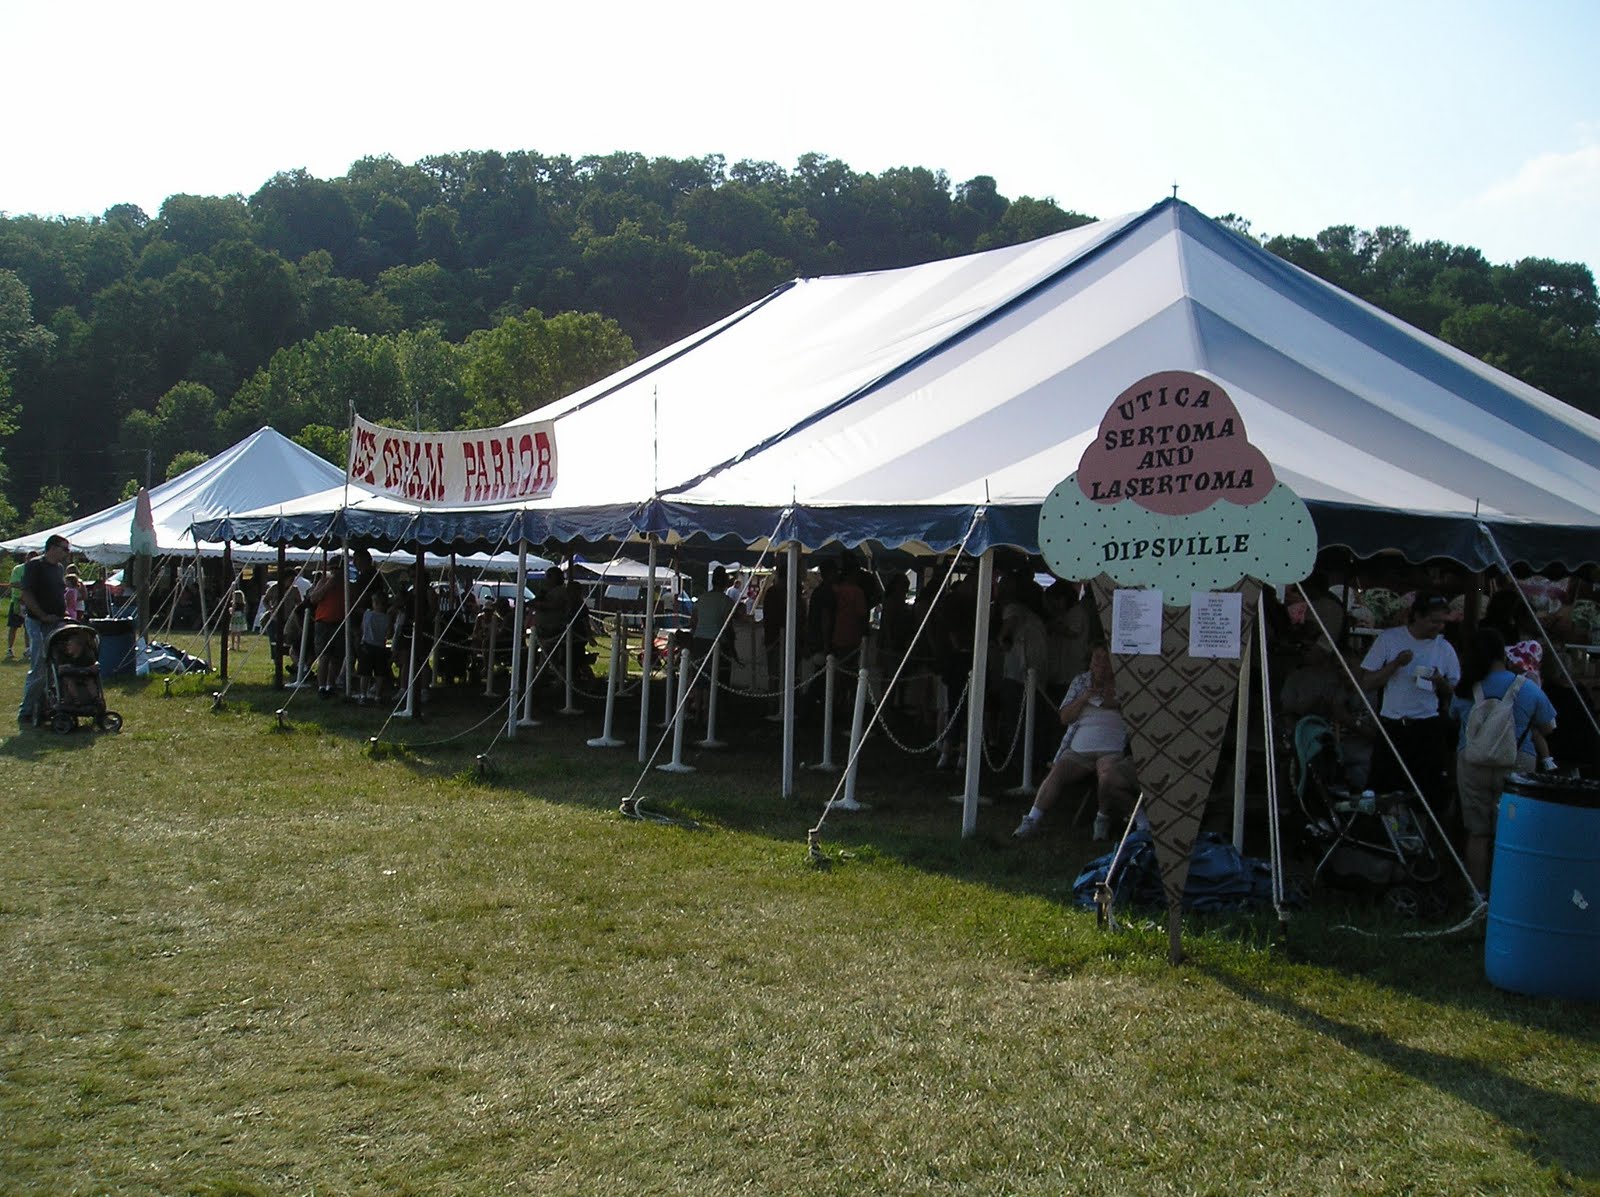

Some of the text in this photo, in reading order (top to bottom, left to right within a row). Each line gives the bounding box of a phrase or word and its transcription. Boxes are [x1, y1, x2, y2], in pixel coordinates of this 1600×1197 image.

[1118, 387, 1212, 421] UTICA
[1104, 418, 1236, 450] SERTOMA
[463, 431, 554, 502] PARLOR
[1136, 445, 1194, 470] AND
[1090, 469, 1255, 501] LASERTOMA
[1102, 534, 1250, 562] DIPSVILLE
